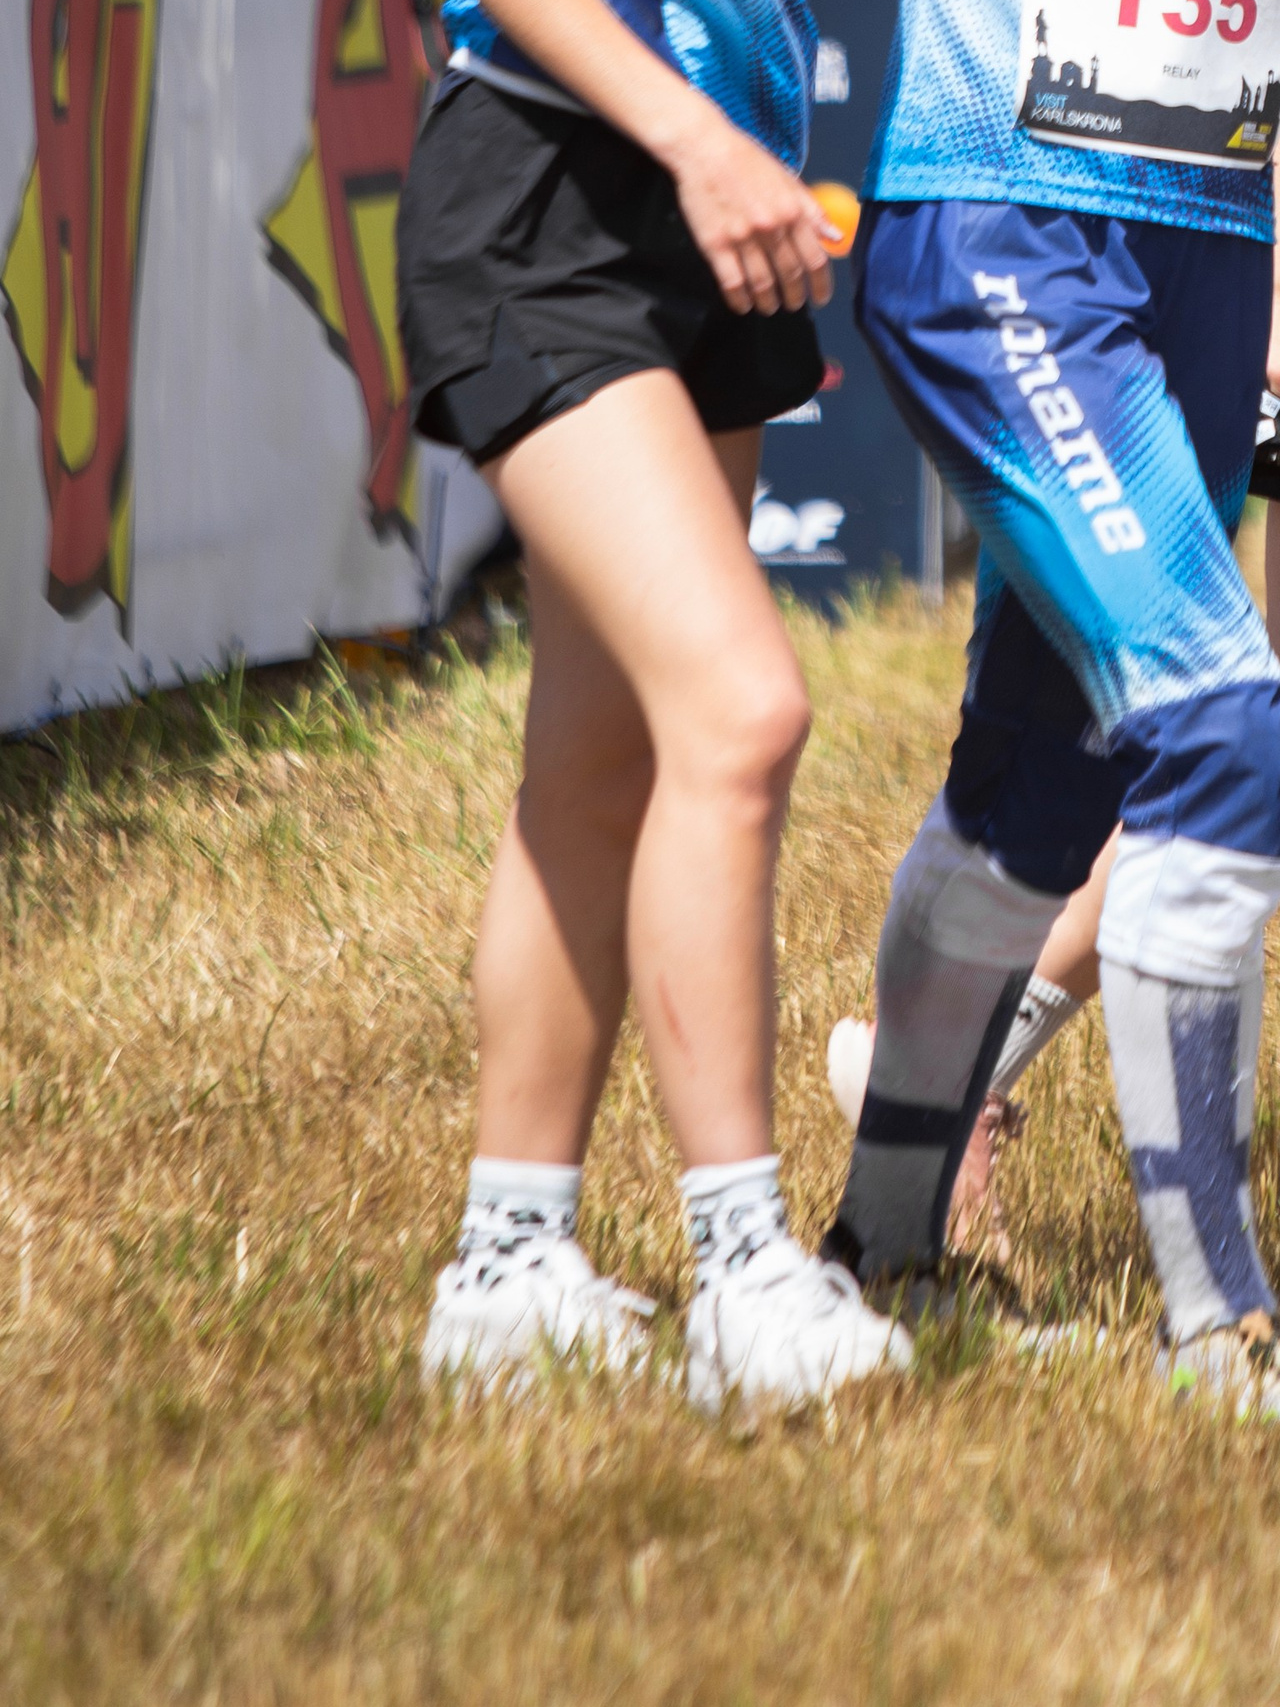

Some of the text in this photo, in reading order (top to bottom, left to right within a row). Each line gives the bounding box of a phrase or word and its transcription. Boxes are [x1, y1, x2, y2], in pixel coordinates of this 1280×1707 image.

[1162, 64, 1201, 81] RELAY
[1034, 92, 1069, 109] VISIT
[1030, 105, 1123, 133] KARLSKRONA
[972, 270, 1147, 555] noname
